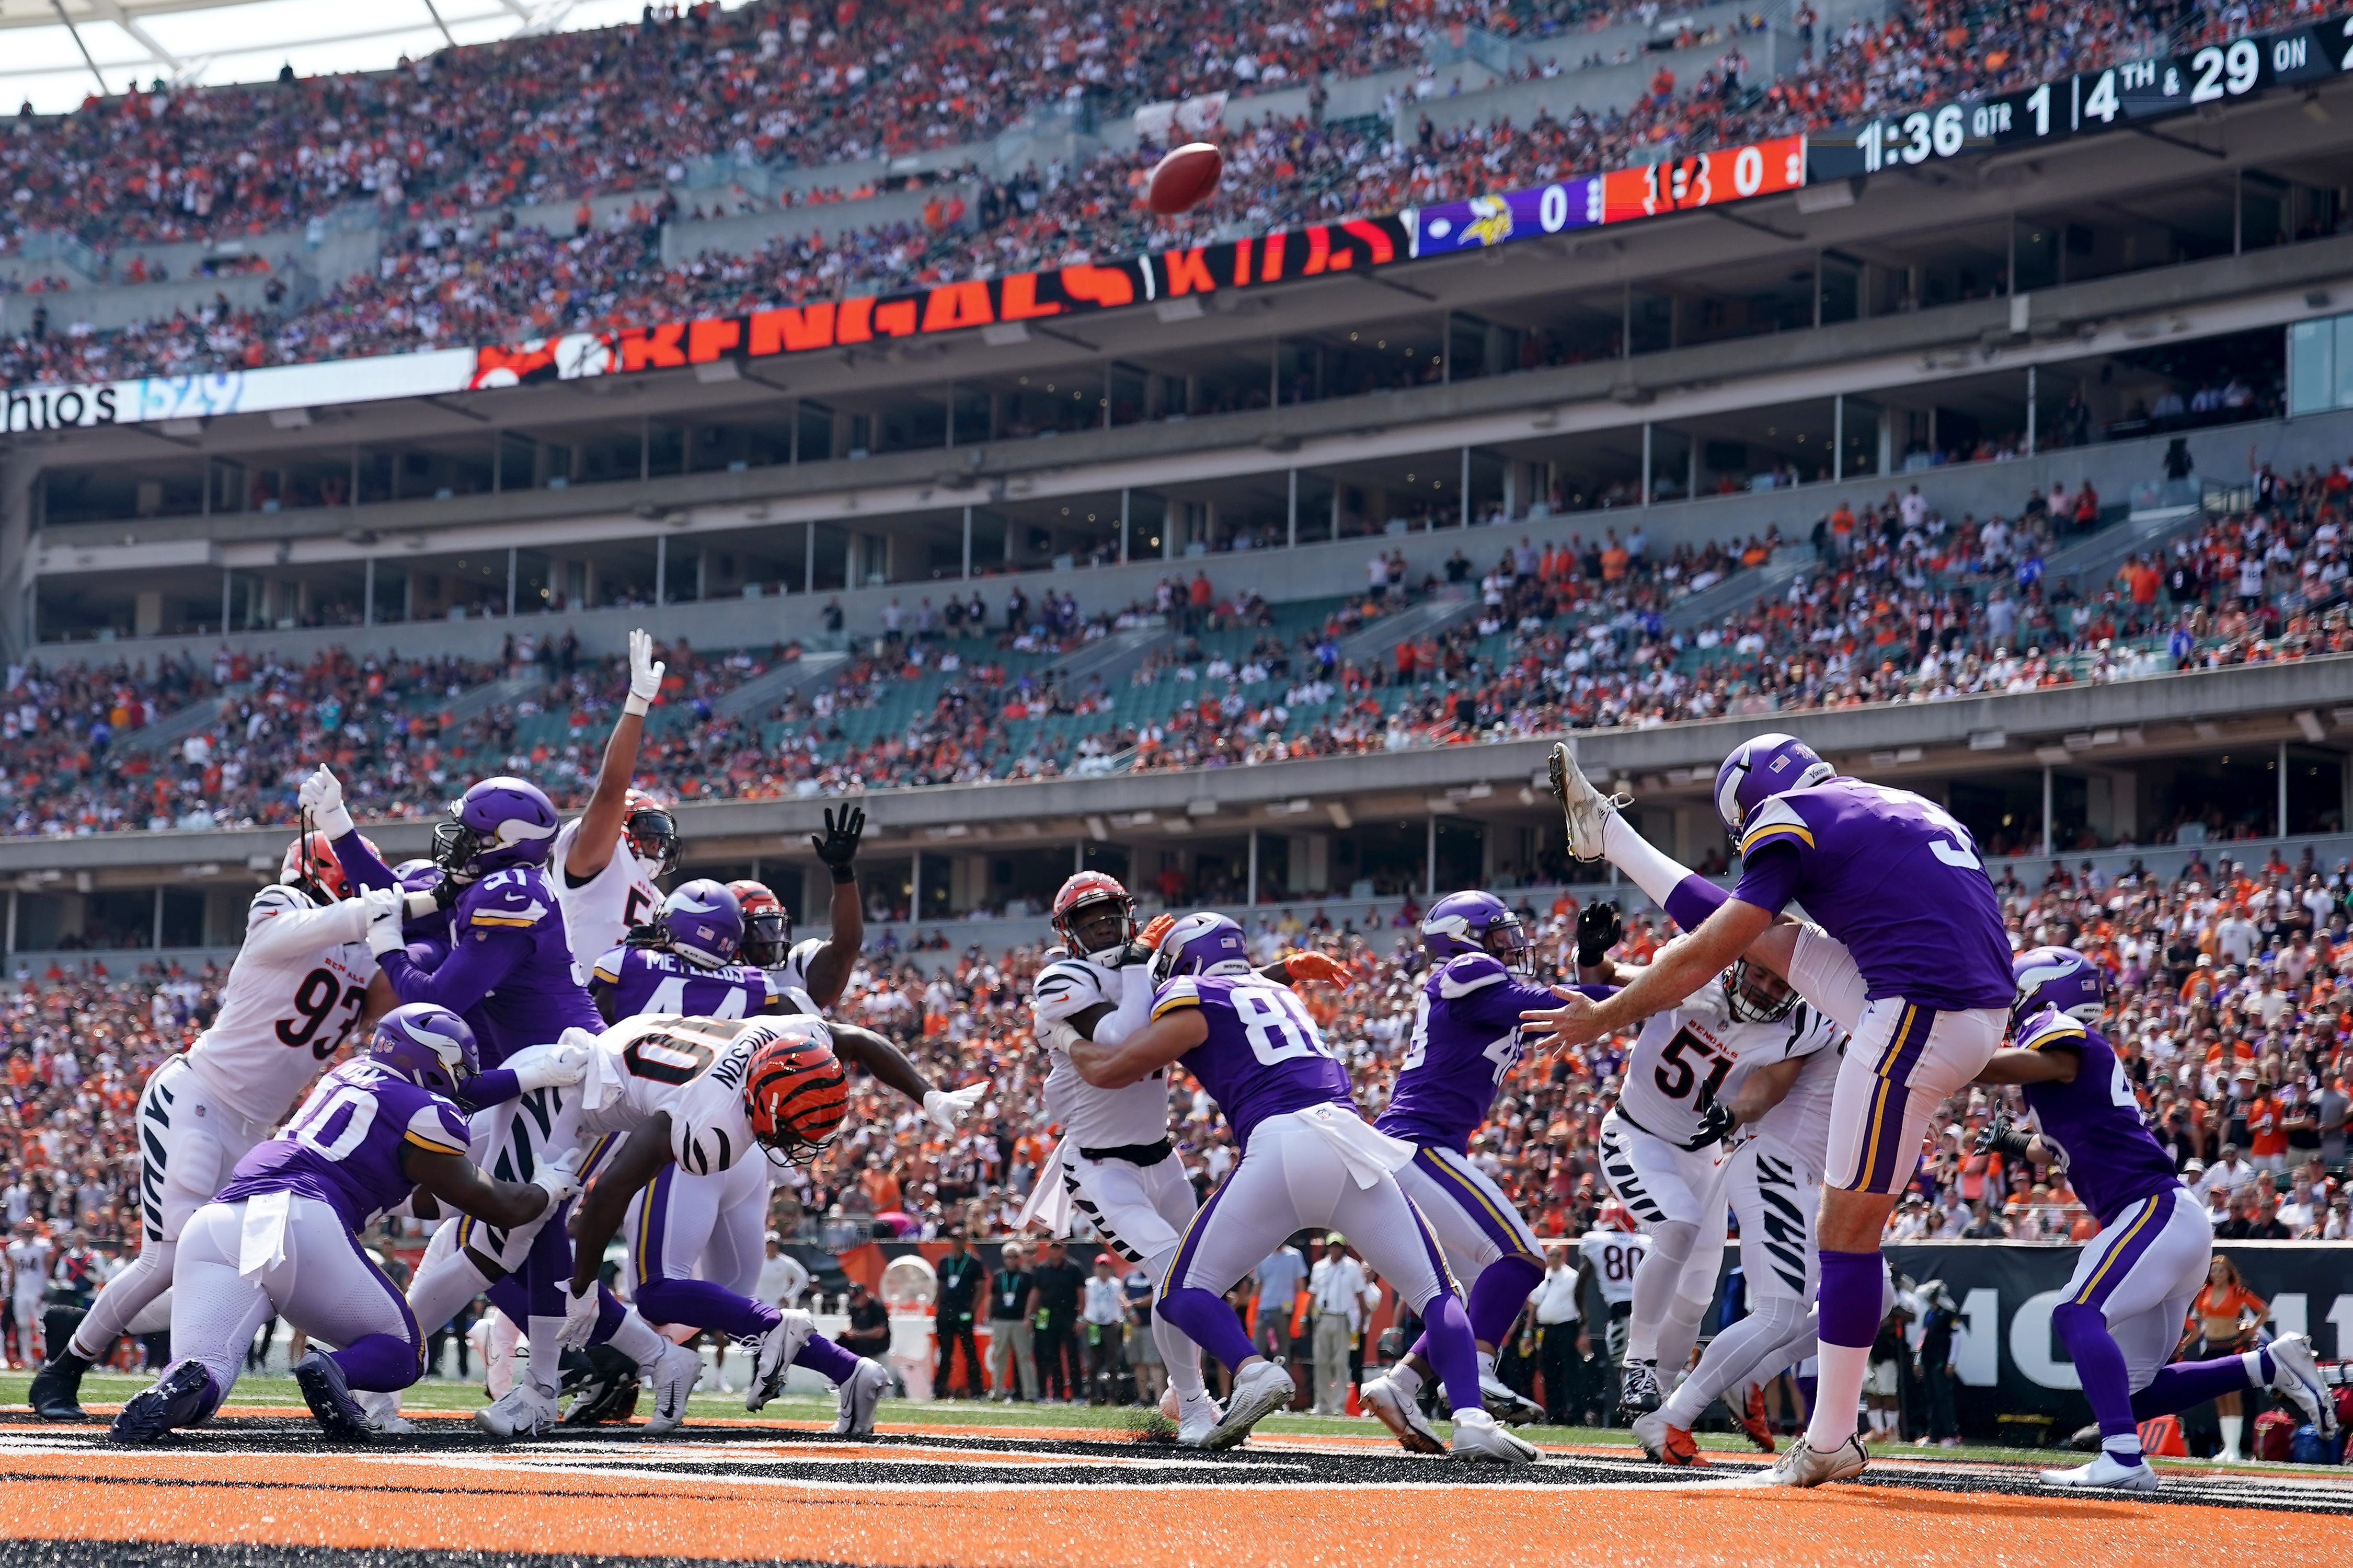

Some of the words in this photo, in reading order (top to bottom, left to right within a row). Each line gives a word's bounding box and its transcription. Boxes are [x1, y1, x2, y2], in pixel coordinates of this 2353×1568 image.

[2162, 66, 2180, 96] &
[2189, 39, 2259, 104] 29
[2273, 36, 2306, 72] ON
[1855, 119, 1964, 173] 1:36
[1972, 102, 2012, 138] QTR
[2026, 84, 2050, 136] 1
[1734, 146, 1763, 197] 0
[1540, 184, 1567, 233] 0
[1877, 789, 1981, 870] 3
[324, 958, 365, 984] BENALS
[276, 968, 366, 1060] 93
[1688, 1019, 1739, 1059] BENGALS
[711, 1026, 779, 1090] WILSON
[1655, 1025, 1735, 1114] 51
[2110, 1044, 2145, 1126] 4
[1604, 1245, 1645, 1281] 80
[2140, 1422, 2166, 1451] 10
